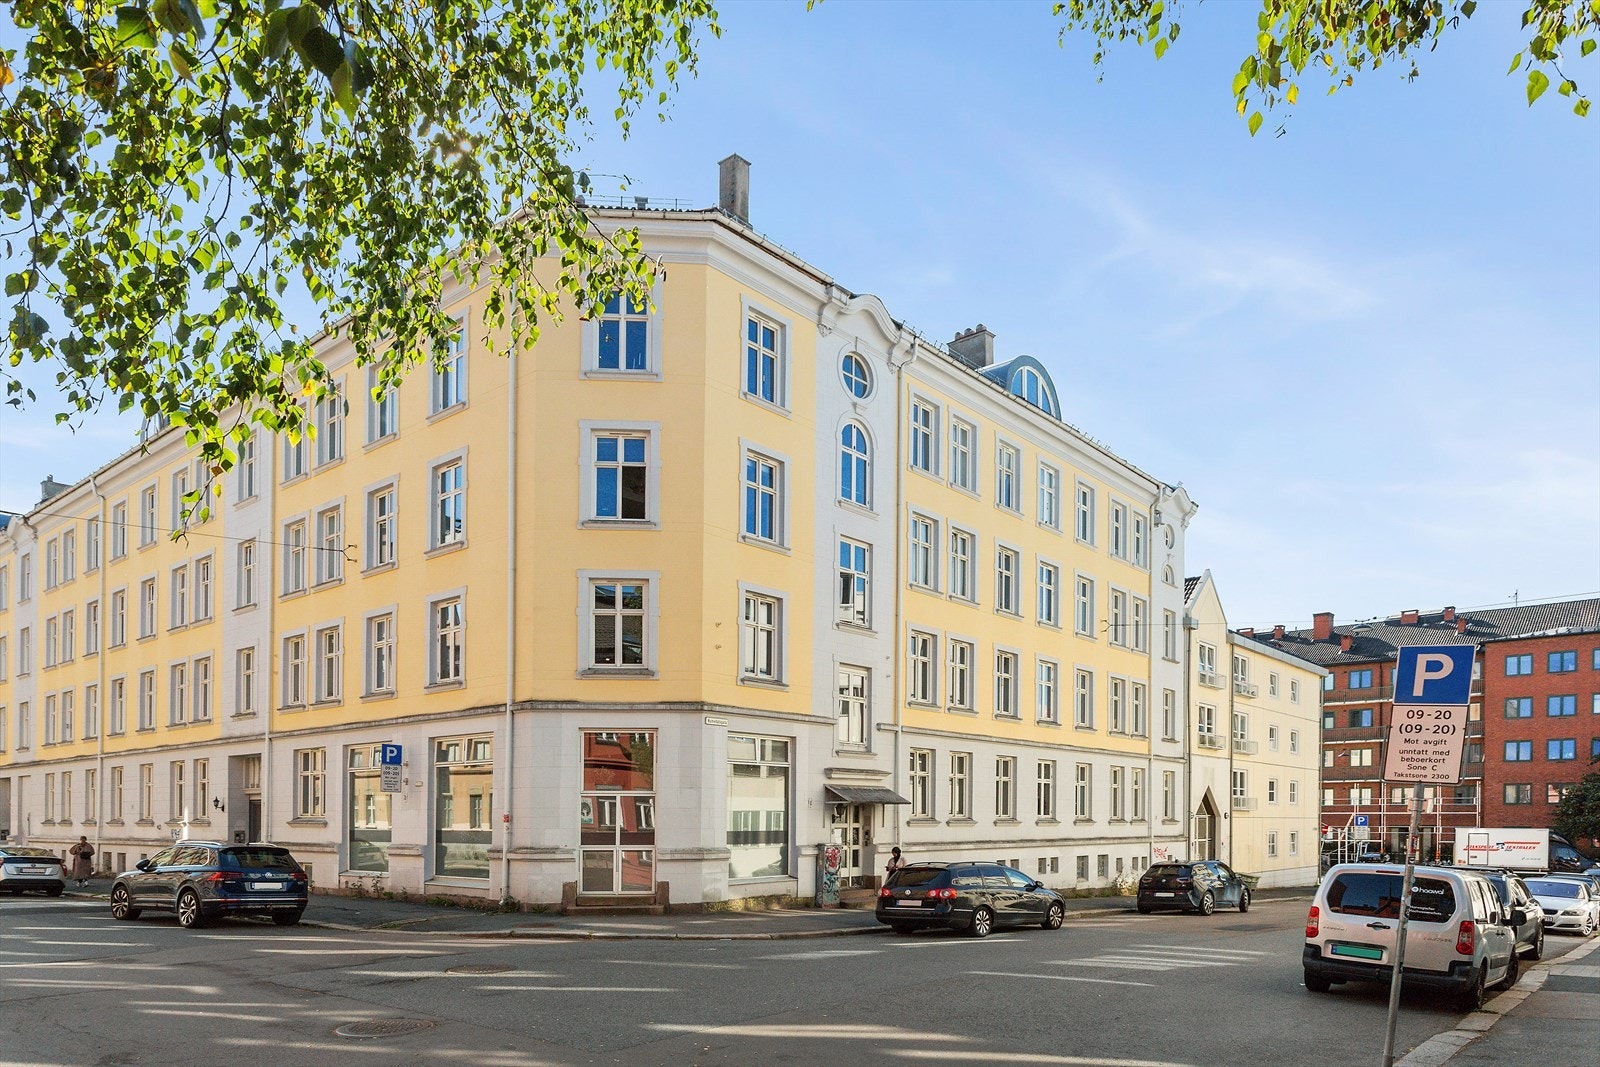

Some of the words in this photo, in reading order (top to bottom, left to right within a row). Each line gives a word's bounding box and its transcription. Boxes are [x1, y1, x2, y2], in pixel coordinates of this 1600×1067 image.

[1412, 653, 1454, 696] P
[1423, 738, 1448, 746] avgift
[386, 746, 398, 762] P
[1358, 816, 1365, 825] P
